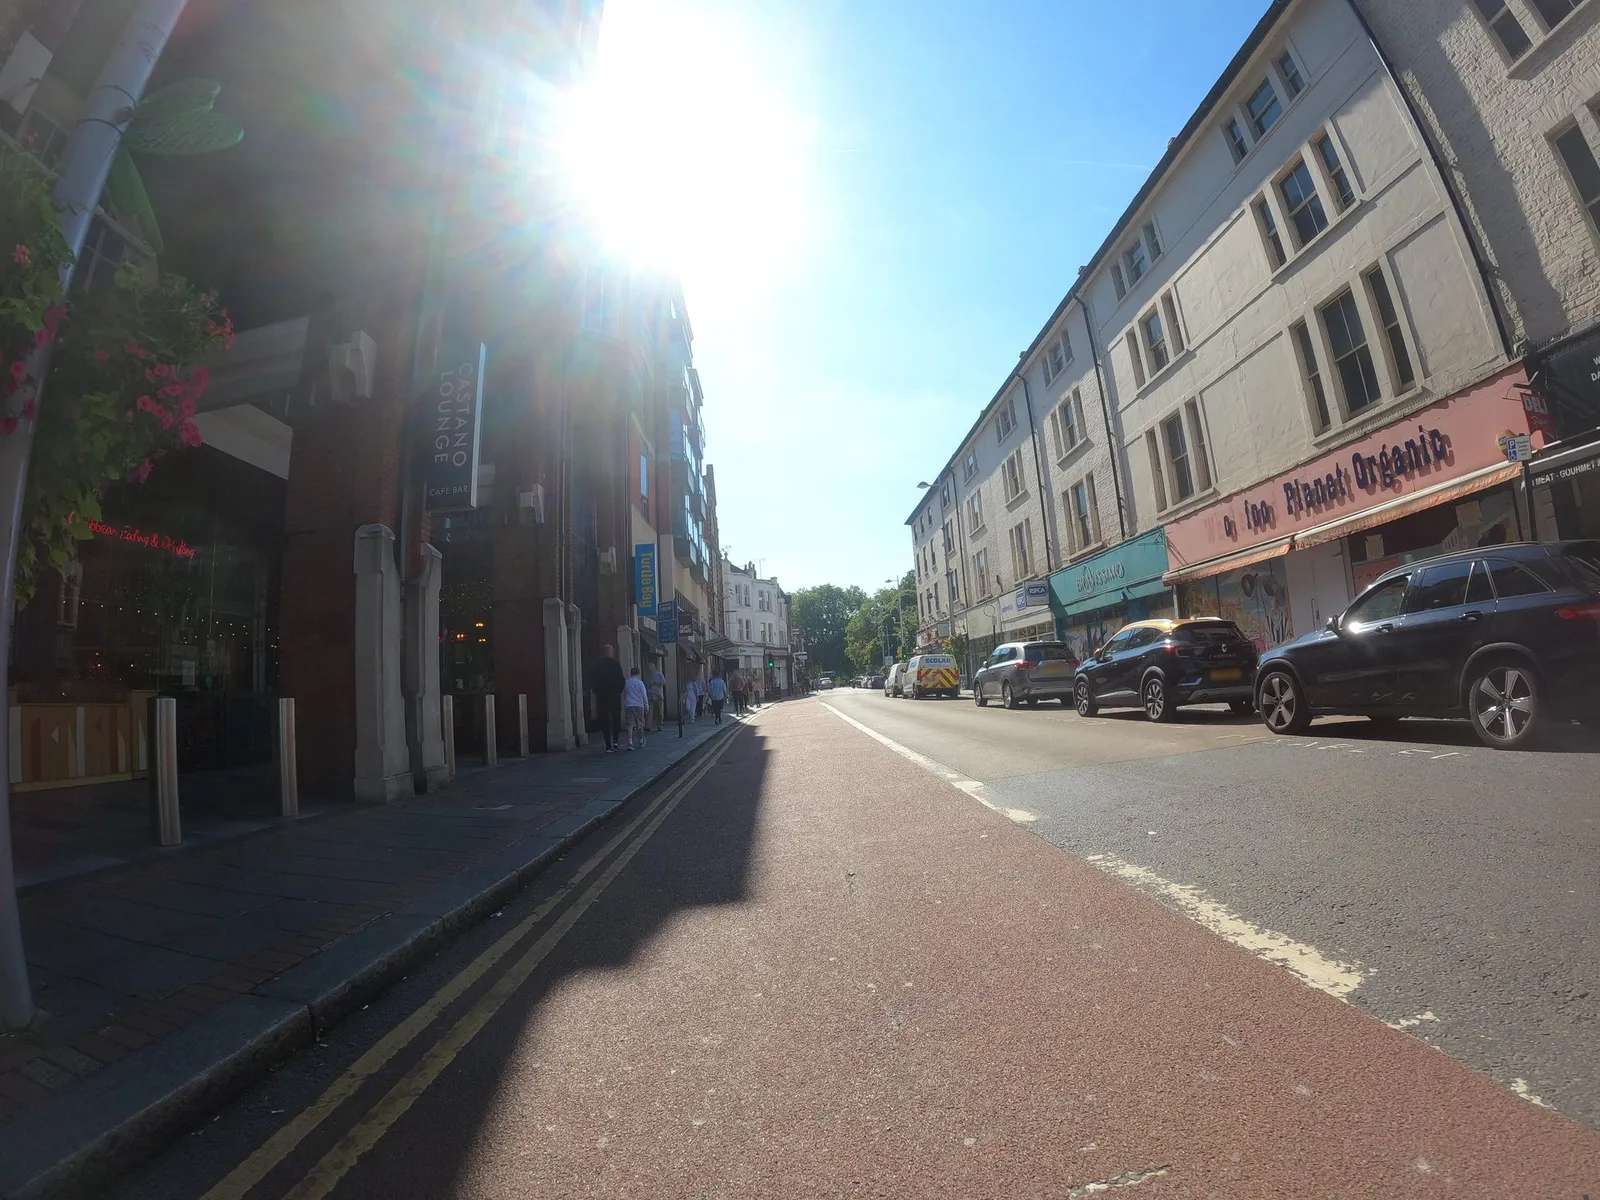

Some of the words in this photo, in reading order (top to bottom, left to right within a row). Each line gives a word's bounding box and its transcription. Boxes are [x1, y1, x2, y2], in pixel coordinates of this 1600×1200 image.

[434, 371, 454, 463] LOUNGE
[452, 362, 474, 467] CASTANO
[1523, 395, 1549, 414] DELI
[1283, 462, 1347, 515] Planet
[1351, 425, 1443, 488] Organic
[1536, 473, 1555, 486] MEAT
[1559, 461, 1596, 478] GOURMET
[429, 486, 450, 496] CAFE
[452, 485, 469, 494] BAR
[641, 552, 653, 585] Turtle
[639, 587, 653, 608] Bay
